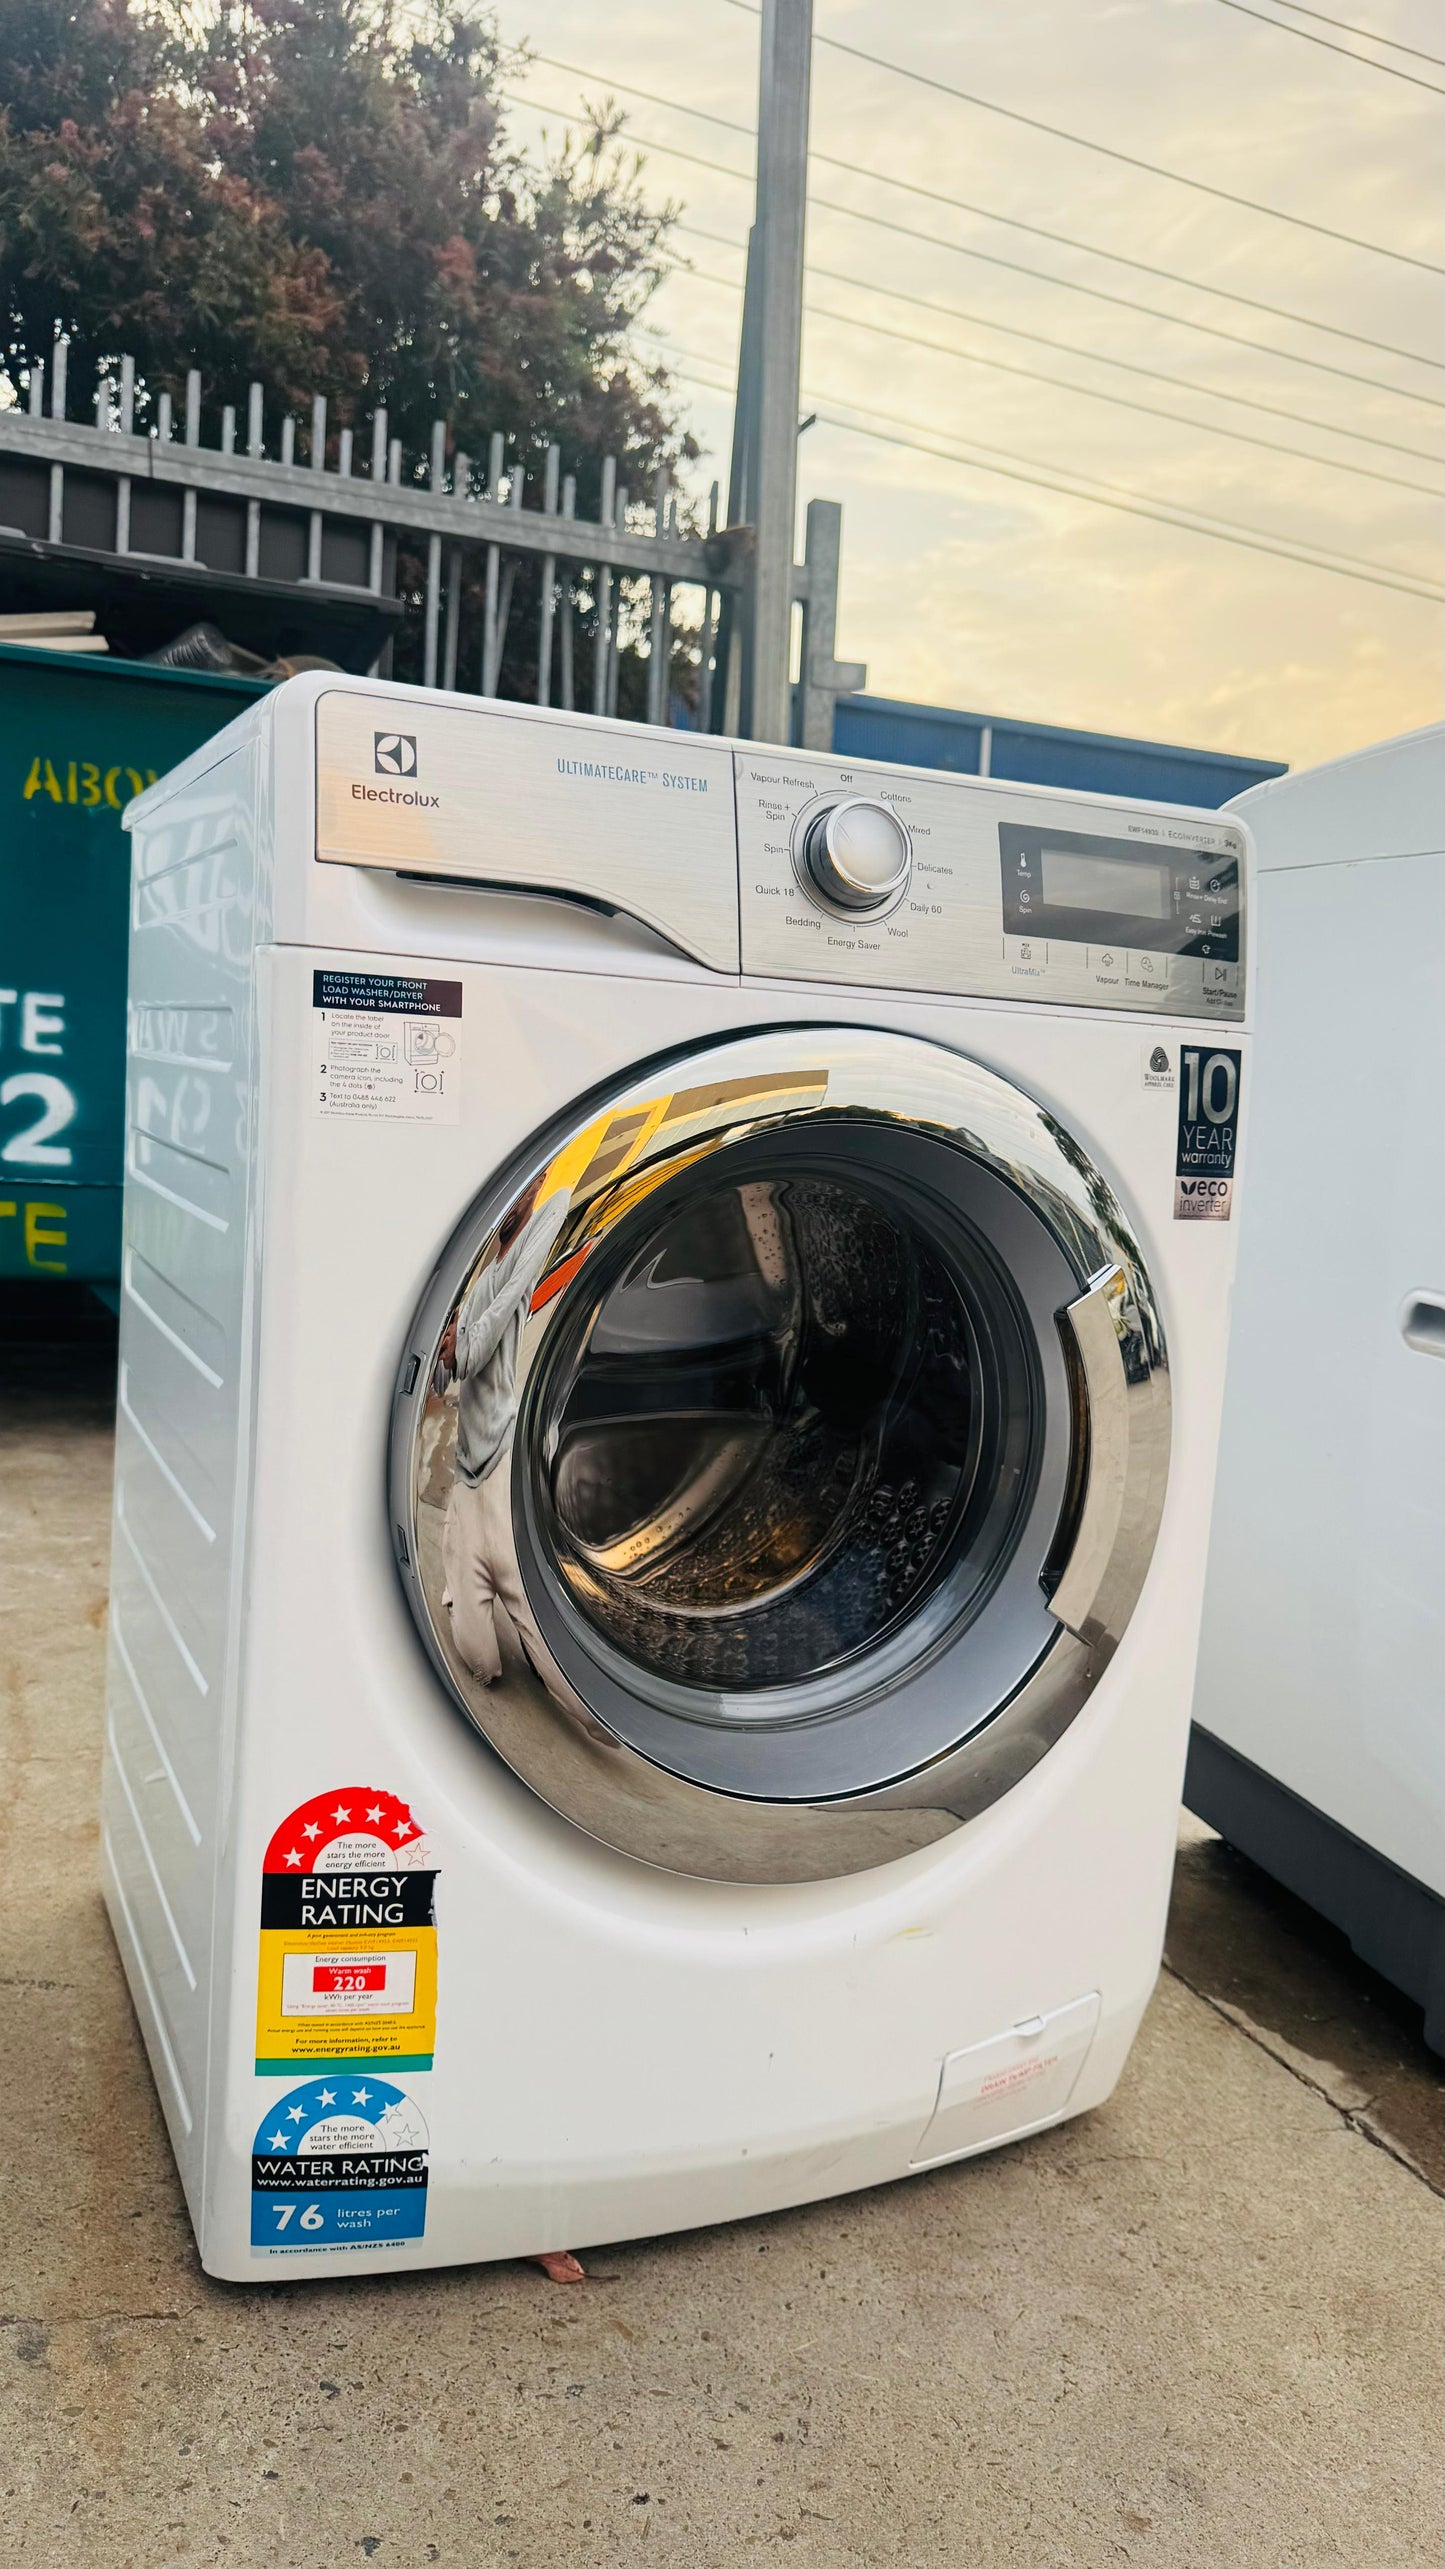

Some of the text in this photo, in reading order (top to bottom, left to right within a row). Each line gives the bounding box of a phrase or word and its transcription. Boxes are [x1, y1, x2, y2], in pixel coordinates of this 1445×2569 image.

[23, 756, 159, 810] ABO
[662, 772, 708, 792] SYSTEM
[751, 772, 815, 789] Vapour Refresh
[840, 774, 853, 783] Off
[352, 784, 440, 808] Electrolux
[880, 791, 912, 803] Cottons
[758, 799, 783, 811] Rinse
[766, 811, 785, 821] Spin
[908, 825, 931, 836] Mixed
[764, 843, 784, 854] Spin
[917, 862, 953, 875] Delicates
[1016, 869, 1032, 879] Temp
[755, 885, 795, 897] Quick 18
[910, 902, 942, 915] Daily 60
[1019, 906, 1032, 914] Spin
[785, 916, 821, 930] Bedding
[887, 927, 909, 938] Wool
[827, 936, 881, 951] Energy Saver
[323, 975, 428, 990] REGISTER YOUR FRONT
[1096, 975, 1119, 985] Vapour
[1124, 978, 1169, 991] Time Manager
[322, 985, 423, 1000] LOAD WASHER/DRYER
[1202, 987, 1237, 999] Start/Pause
[322, 995, 441, 1012] WITH YOUR SMARTPHONE
[321, 1012, 326, 1021] 1
[331, 1012, 354, 1020] Locate
[368, 1014, 384, 1022] label
[354, 1022, 372, 1030] inside
[347, 1030, 373, 1038] product
[320, 1064, 327, 1074] 2
[330, 1064, 369, 1074] Photograph
[374, 1076, 403, 1084] including
[1144, 1073, 1175, 1082] WOOLMARK
[1184, 1052, 1237, 1124] 10
[320, 1092, 327, 1102] 3
[329, 1100, 360, 1109] (Australia
[0, 1072, 75, 1165] 2
[1183, 1125, 1233, 1151] YEAR
[1181, 1151, 1231, 1168] warranty
[1197, 1181, 1228, 1196] eco
[1180, 1196, 1226, 1212] inverter
[338, 1841, 353, 1849] The
[348, 1851, 362, 1859] the
[325, 1860, 386, 1870] energy efficient
[301, 1876, 409, 1899] ENERGY
[301, 1903, 404, 1925] RATING
[315, 1954, 386, 1964] Energy consumption
[329, 1966, 372, 1975] Warm wash
[333, 1976, 366, 1991] 220
[324, 1993, 373, 2002] kWh per year
[328, 2036, 370, 2044] information,
[291, 2044, 401, 2054] www.energyrating.gov.au
[320, 2125, 338, 2133] The
[333, 2133, 349, 2141] the
[338, 2142, 374, 2150] efficient
[257, 2156, 424, 2176] WATER RATING
[257, 2175, 423, 2188] www.waterrating.gov.au
[272, 2204, 324, 2231] 76
[337, 2208, 400, 2218] litres per
[337, 2219, 372, 2229] wash
[349, 2243, 383, 2251] AS/NZS
